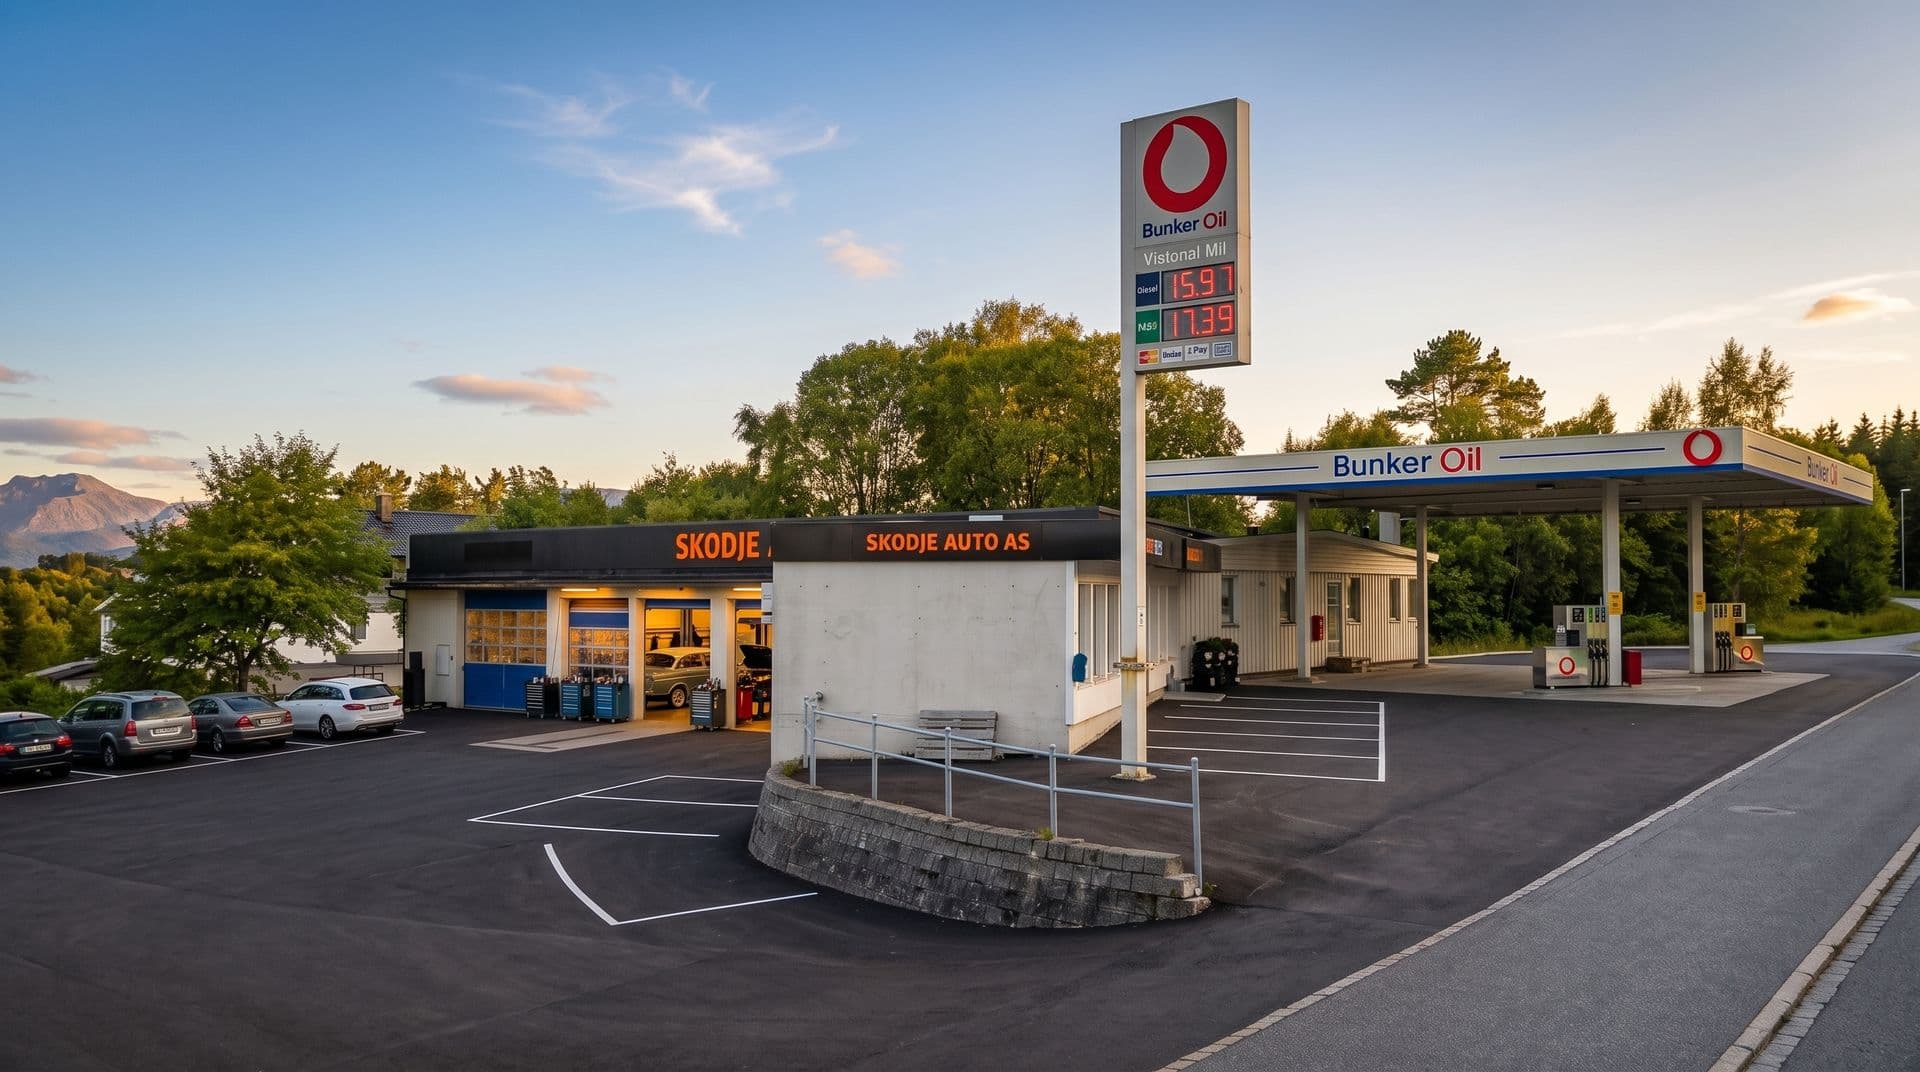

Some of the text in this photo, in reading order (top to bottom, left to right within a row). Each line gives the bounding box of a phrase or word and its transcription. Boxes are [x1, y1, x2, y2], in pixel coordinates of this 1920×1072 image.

[1142, 210, 1227, 239] Bunker Oil
[1143, 241, 1226, 266] Vistonal Mil
[1172, 264, 1233, 299] 15.97
[1172, 304, 1233, 338] 17.39
[1334, 446, 1481, 477] Bunker Oil
[1807, 455, 1829, 483] Bunker
[675, 531, 760, 562] SKODJE
[866, 532, 1031, 554] SKODJE AUTO AS
